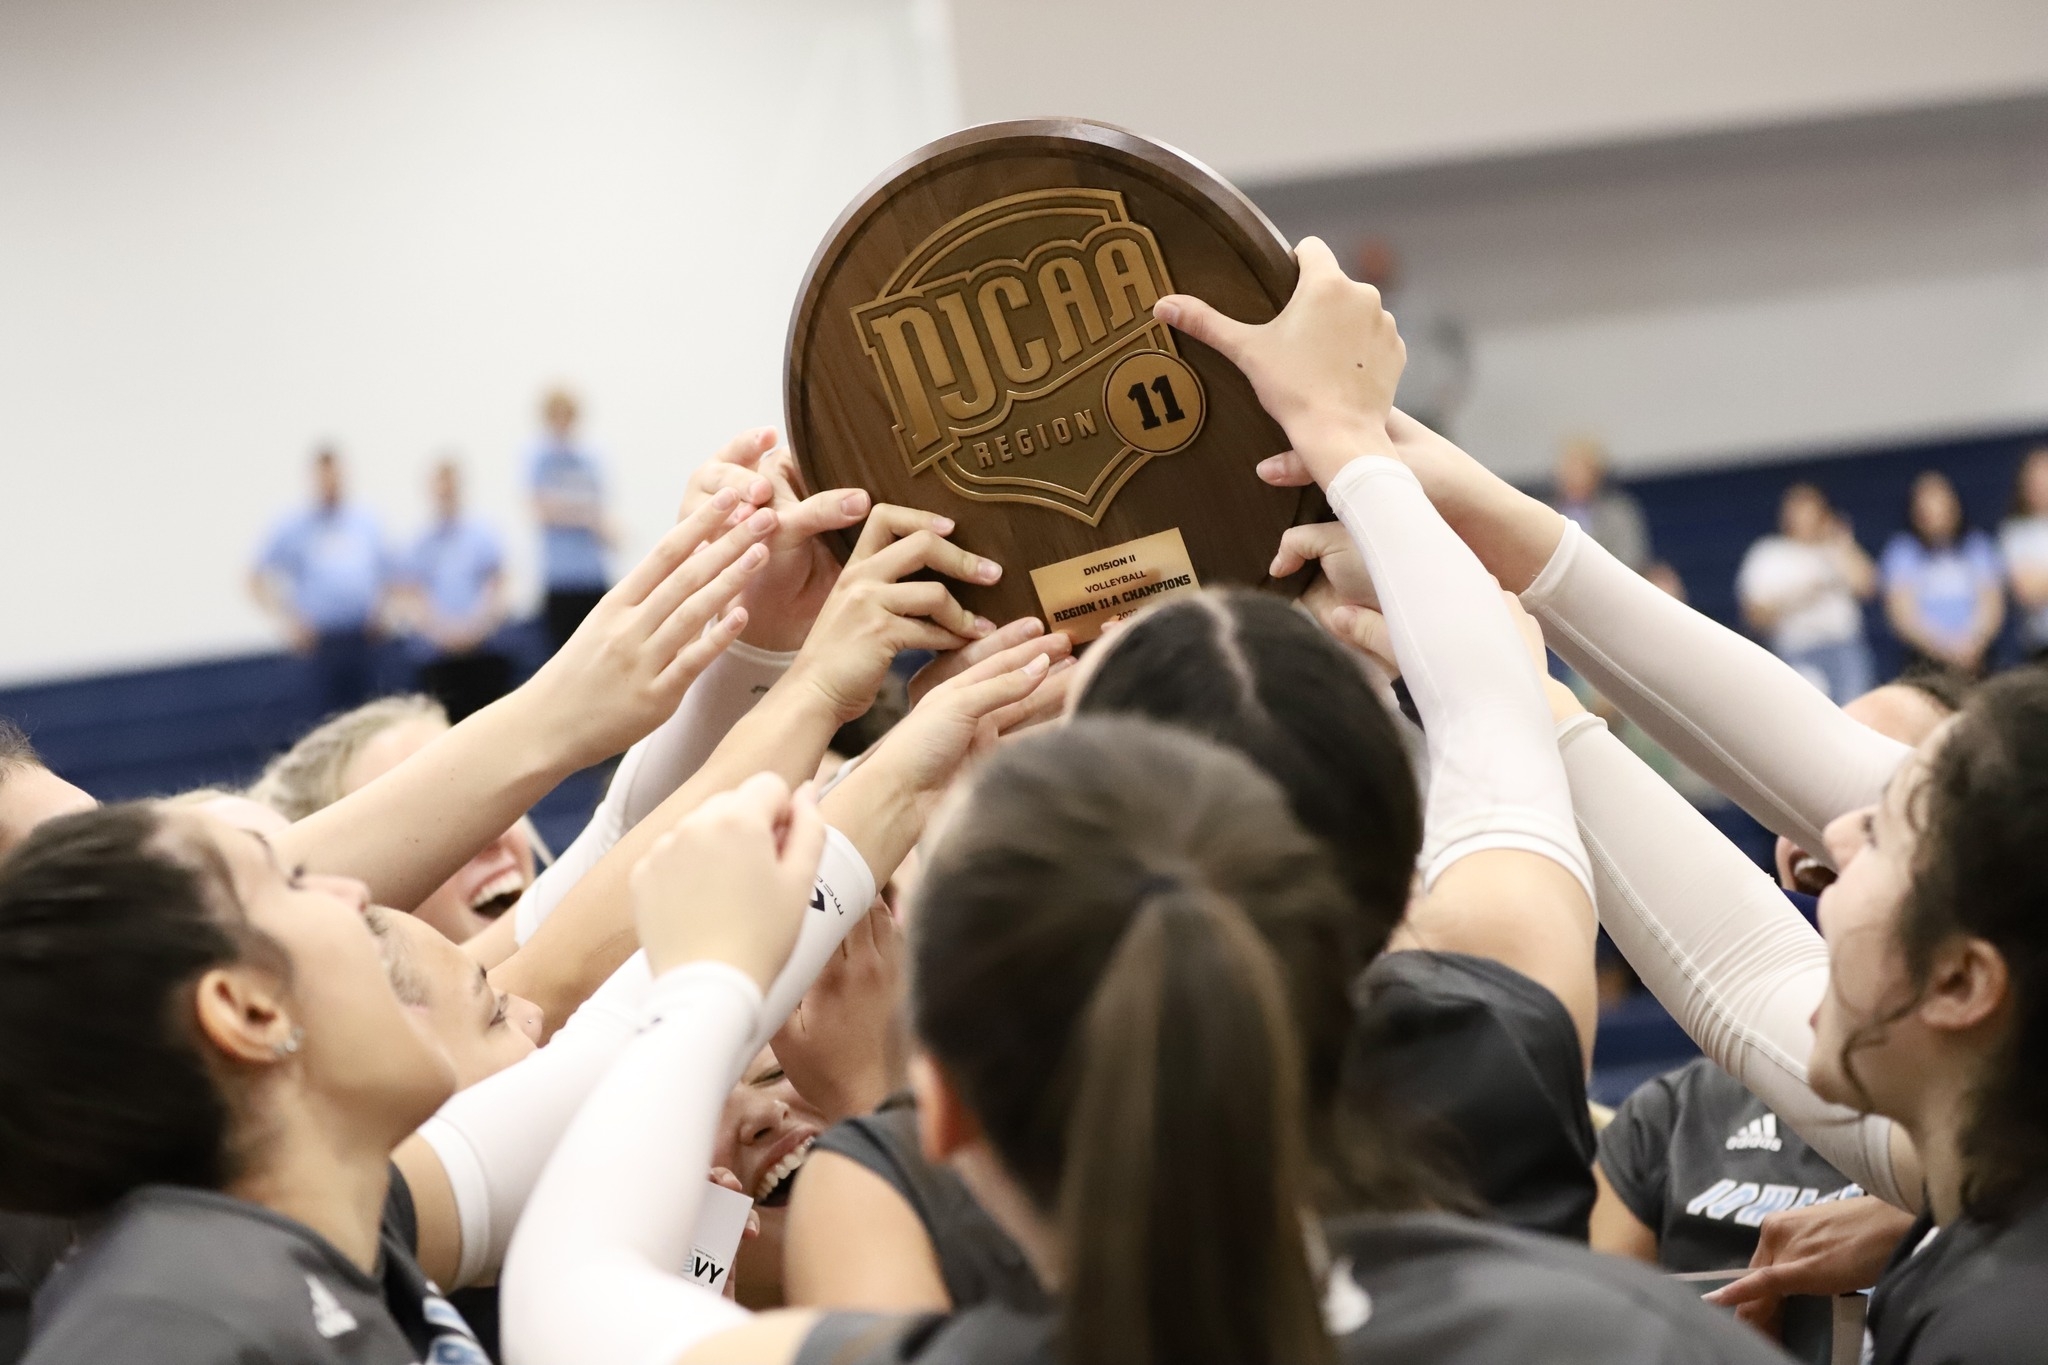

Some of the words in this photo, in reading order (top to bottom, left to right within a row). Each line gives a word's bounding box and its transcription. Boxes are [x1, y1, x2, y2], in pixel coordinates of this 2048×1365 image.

[870, 237, 1155, 453] NJCAA
[1127, 375, 1186, 431] 11
[972, 409, 1097, 469] REGION
[1083, 557, 1128, 576] DIVISION
[1129, 554, 1136, 563] II
[1085, 570, 1147, 594] VOLLEYBALL
[1053, 602, 1097, 622] REGION
[1122, 574, 1191, 603] CHAMPIONS
